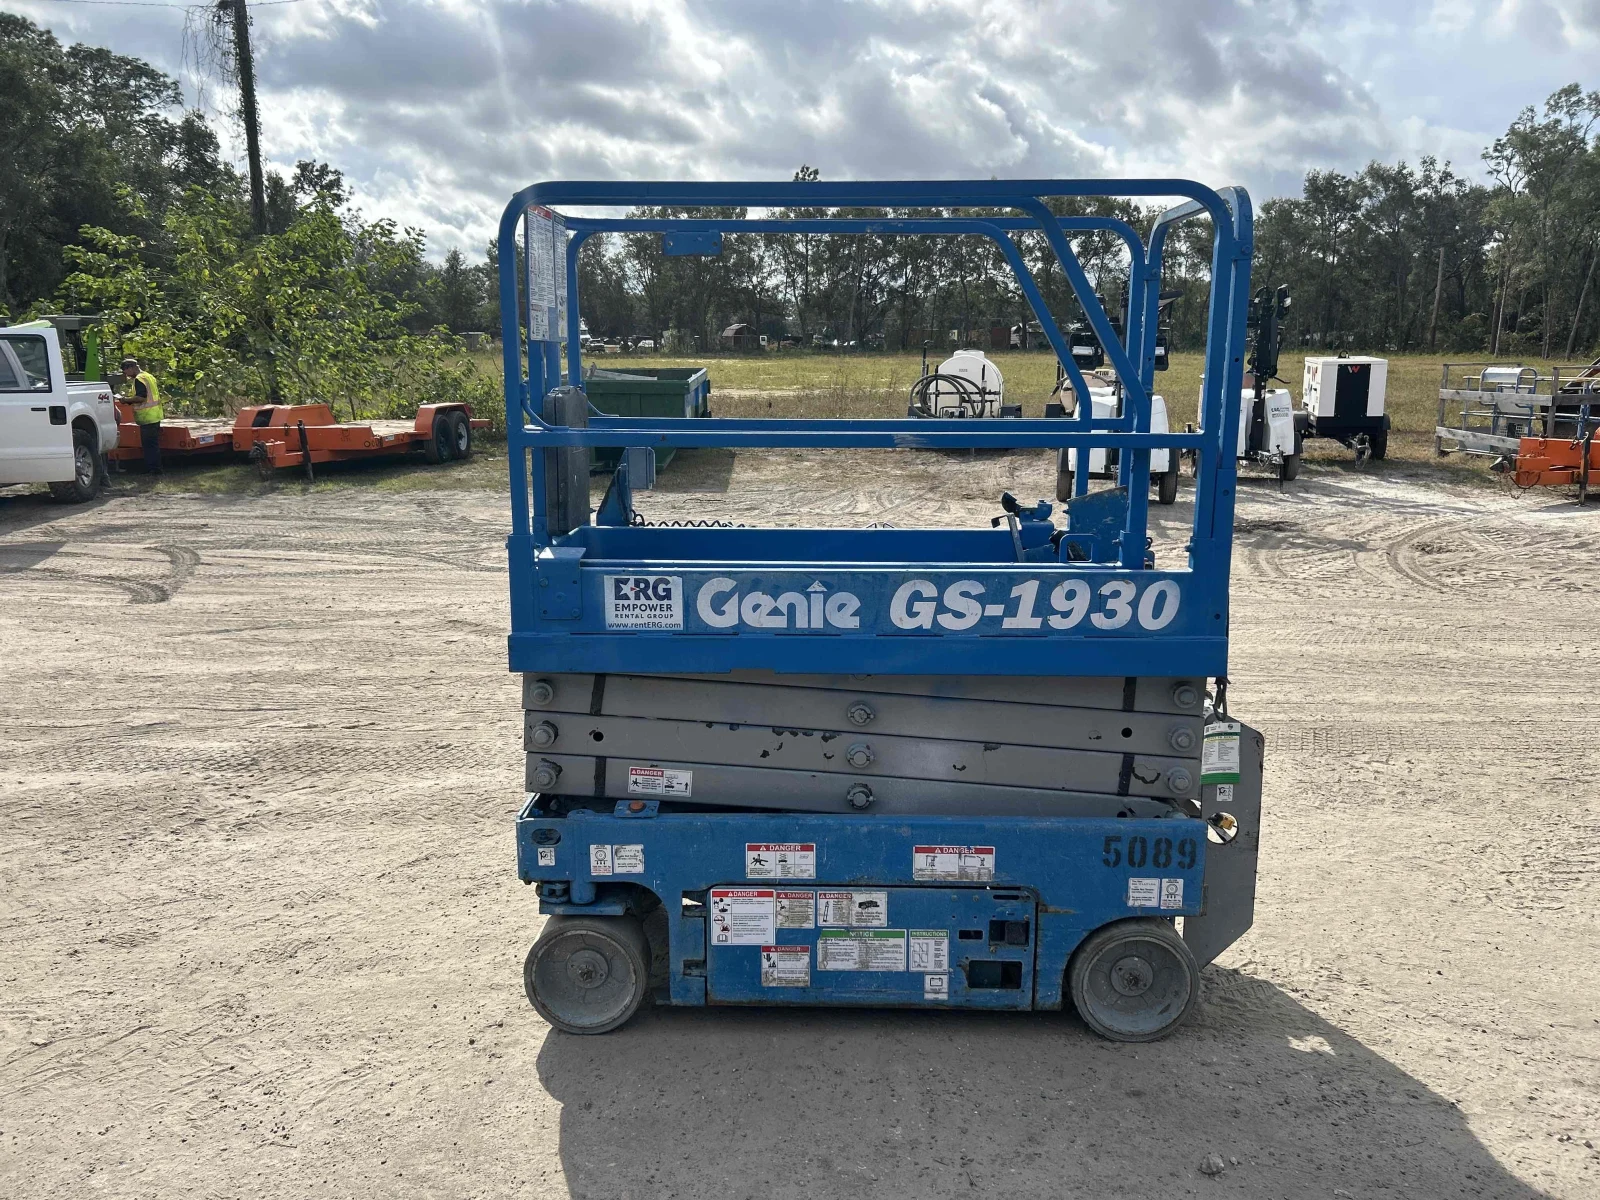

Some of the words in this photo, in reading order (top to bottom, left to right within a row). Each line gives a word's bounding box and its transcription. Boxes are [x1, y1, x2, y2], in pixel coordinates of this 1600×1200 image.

[614, 577, 672, 601] ERG
[696, 577, 861, 629] Genie
[615, 603, 673, 612] EMPOWER
[890, 578, 1181, 631] GS-1930
[608, 621, 681, 629] www.rentERG.com
[1102, 835, 1197, 870] 5089
